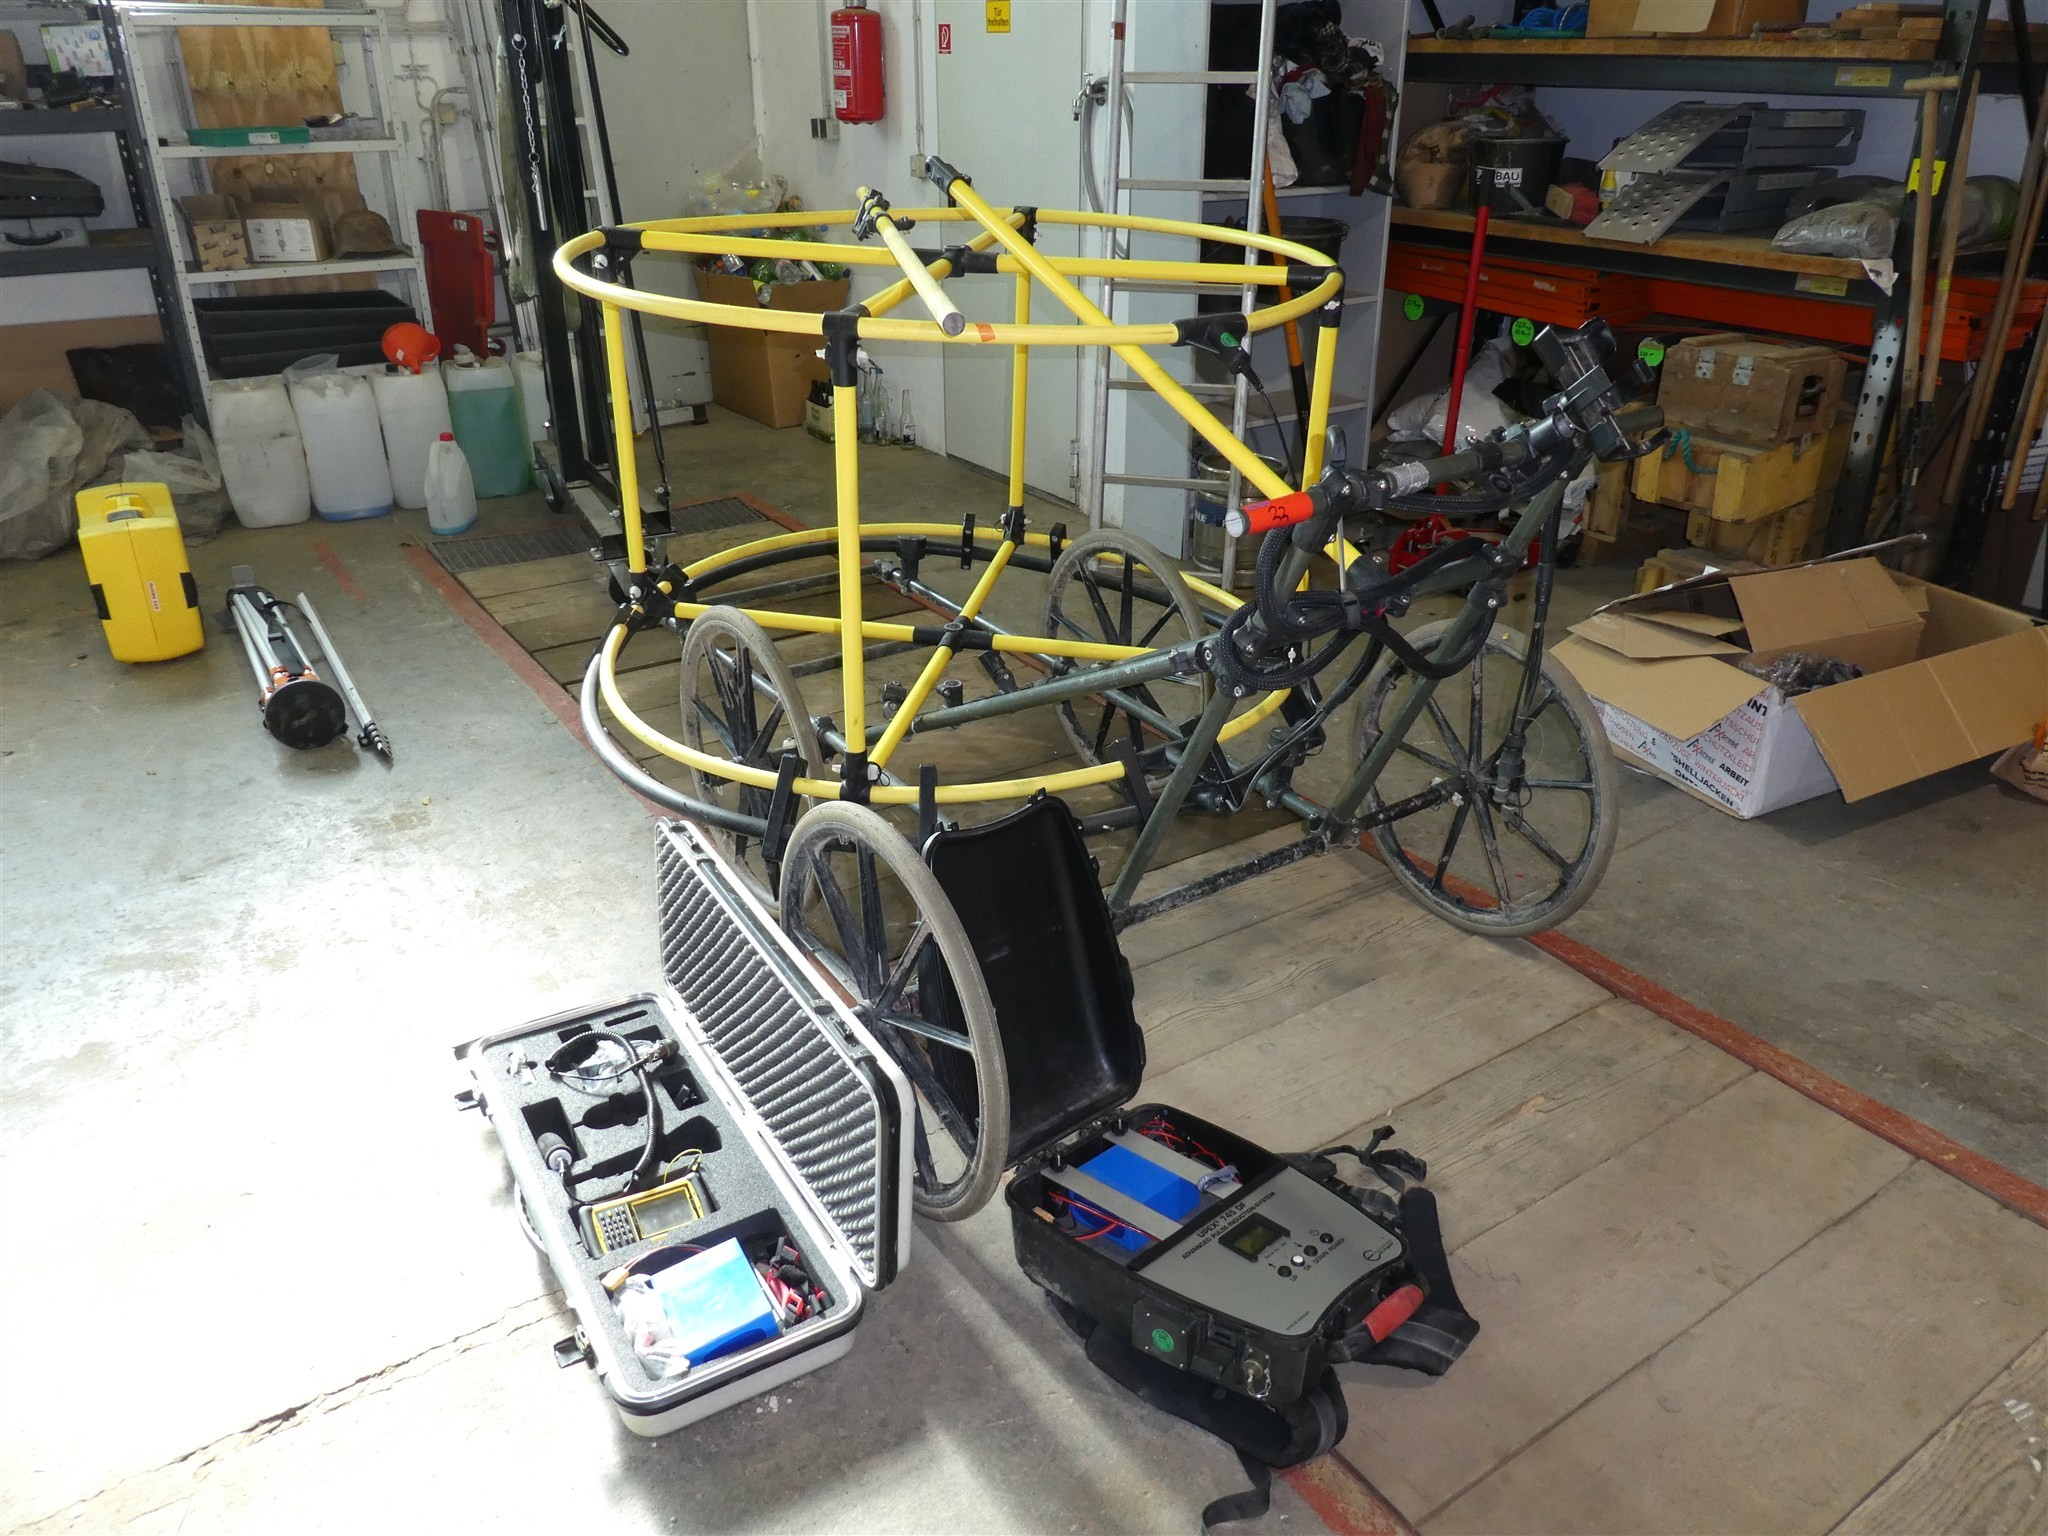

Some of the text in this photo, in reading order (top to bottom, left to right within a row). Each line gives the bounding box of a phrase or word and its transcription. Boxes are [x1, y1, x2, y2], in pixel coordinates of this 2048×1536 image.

[1495, 171, 1520, 181] BAU
[1268, 505, 1289, 522] 22
[1719, 763, 1750, 787] ARBEIT
[1220, 1210, 1237, 1222] 745
[1235, 1201, 1247, 1211] DF
[1182, 1236, 1213, 1259] ADVANCED
